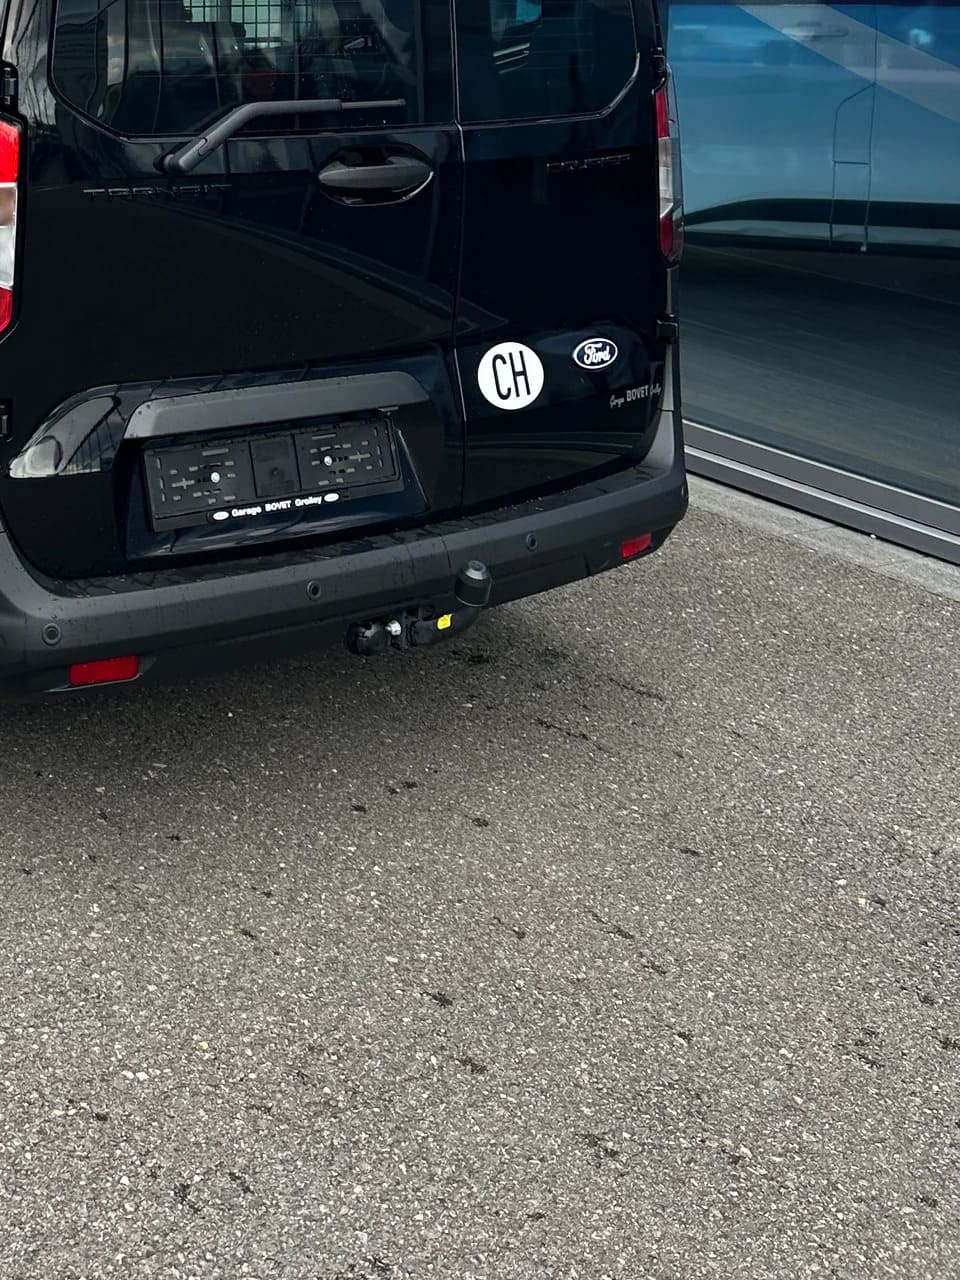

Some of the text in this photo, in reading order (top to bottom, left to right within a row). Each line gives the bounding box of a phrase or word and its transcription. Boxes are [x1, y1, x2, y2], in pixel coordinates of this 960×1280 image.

[583, 342, 611, 365] Ford
[492, 350, 531, 400] CH
[626, 385, 649, 401] BOVET
[231, 506, 262, 517] Garage
[265, 500, 292, 512] BOVET
[294, 495, 322, 507] Grolley
